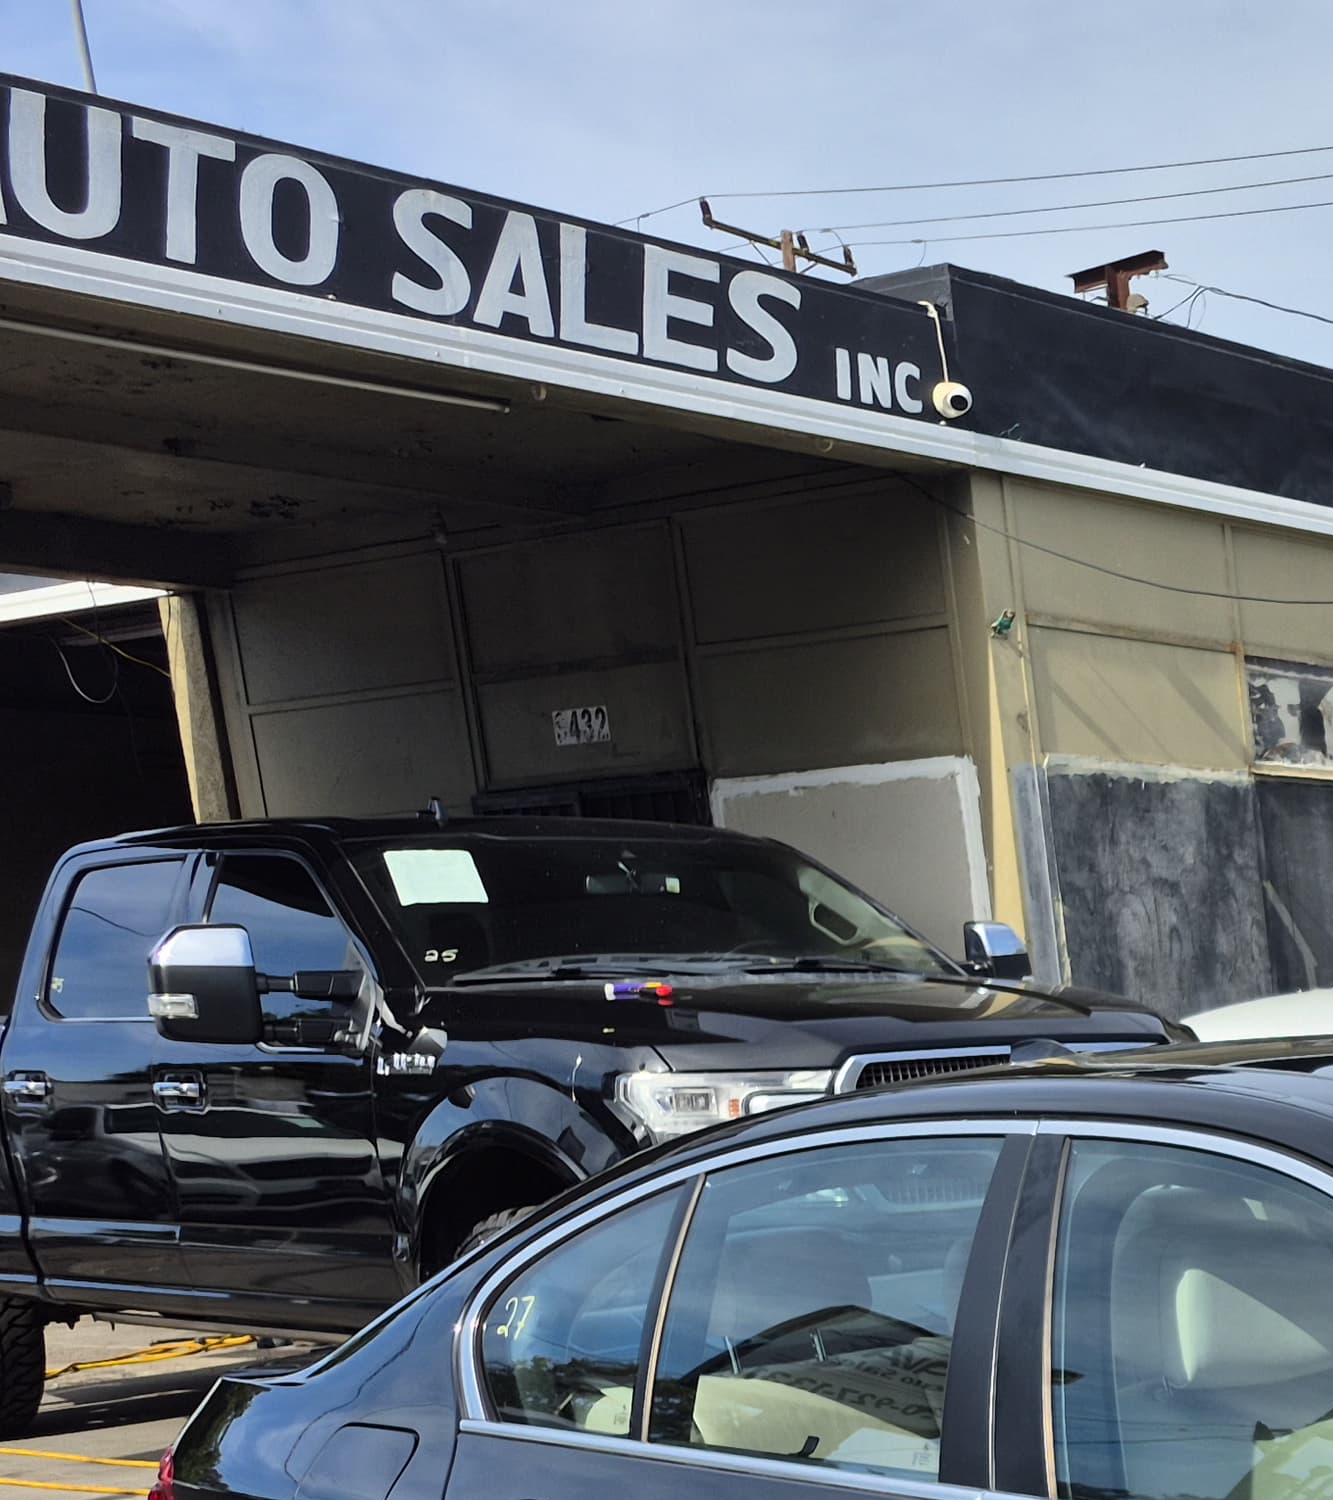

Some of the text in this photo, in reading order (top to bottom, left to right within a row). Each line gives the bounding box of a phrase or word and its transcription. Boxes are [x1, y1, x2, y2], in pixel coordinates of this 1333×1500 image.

[0, 87, 923, 413] UTO SALES INC
[496, 1295, 536, 1341] 27
